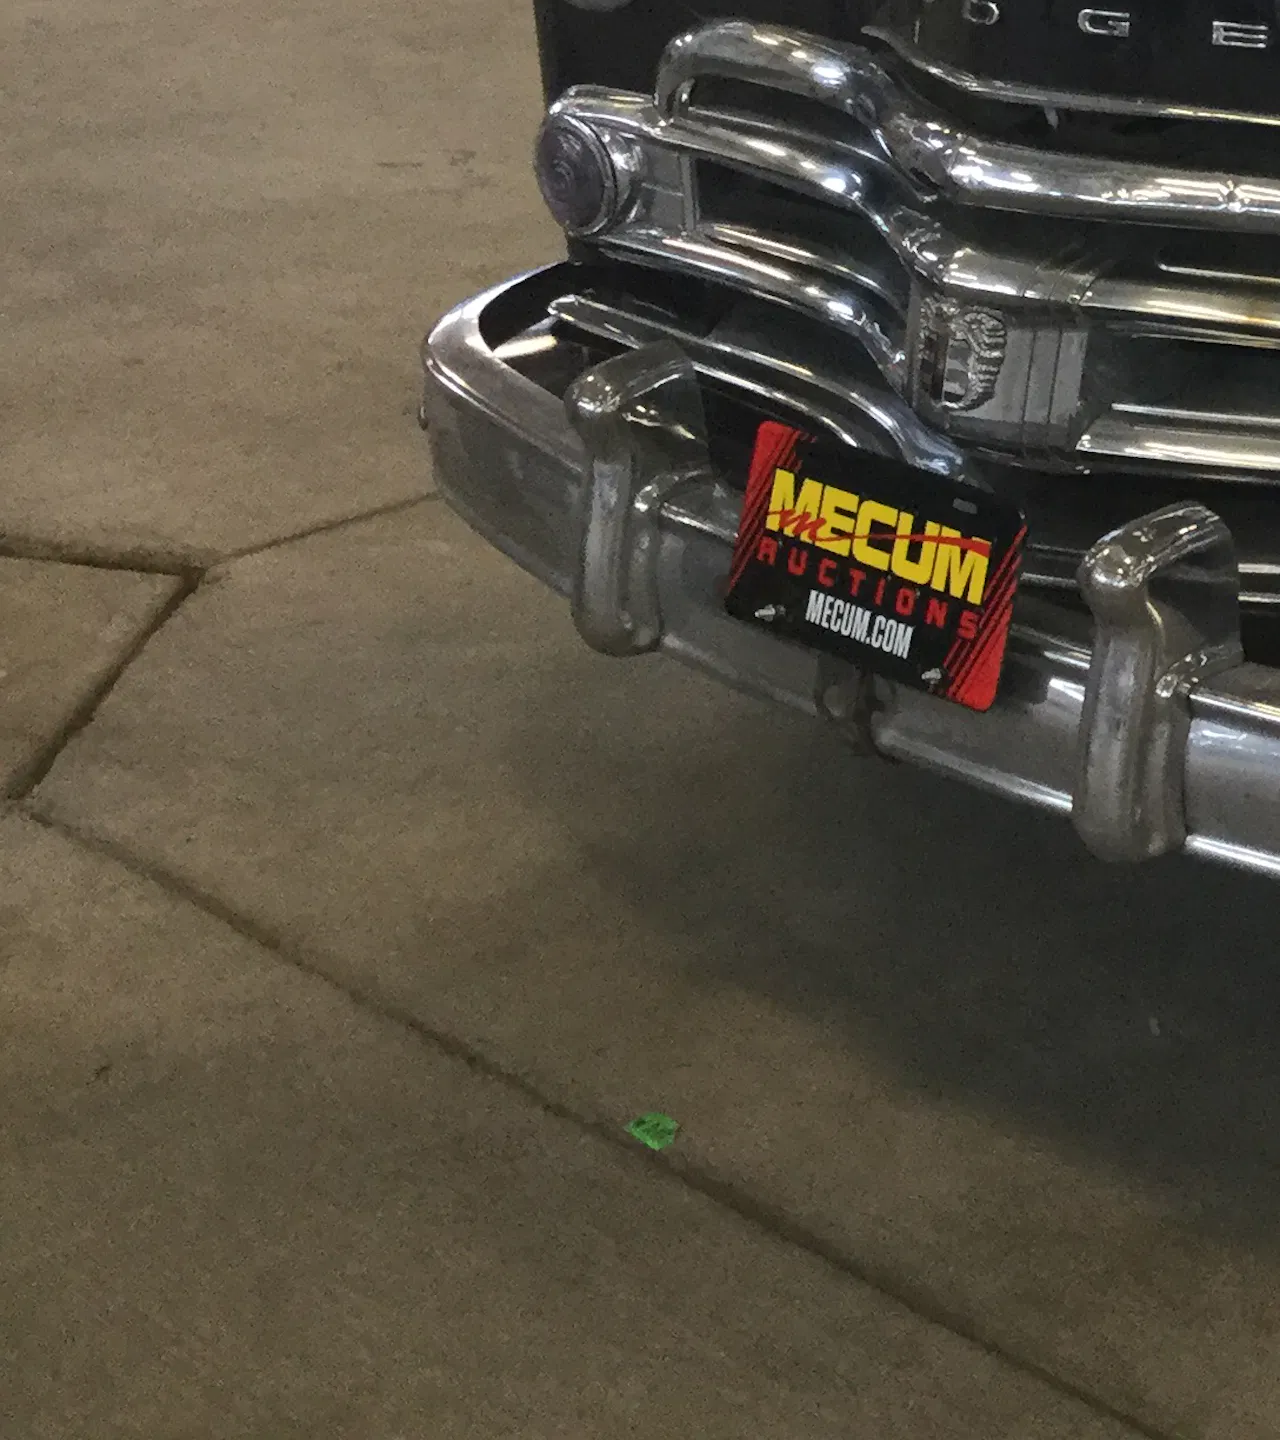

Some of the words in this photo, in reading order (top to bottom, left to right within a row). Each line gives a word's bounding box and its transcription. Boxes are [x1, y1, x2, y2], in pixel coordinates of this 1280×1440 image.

[755, 535, 983, 641] AUCTIONS
[765, 467, 992, 606] MECUM
[804, 588, 916, 660] MECUM.COM
